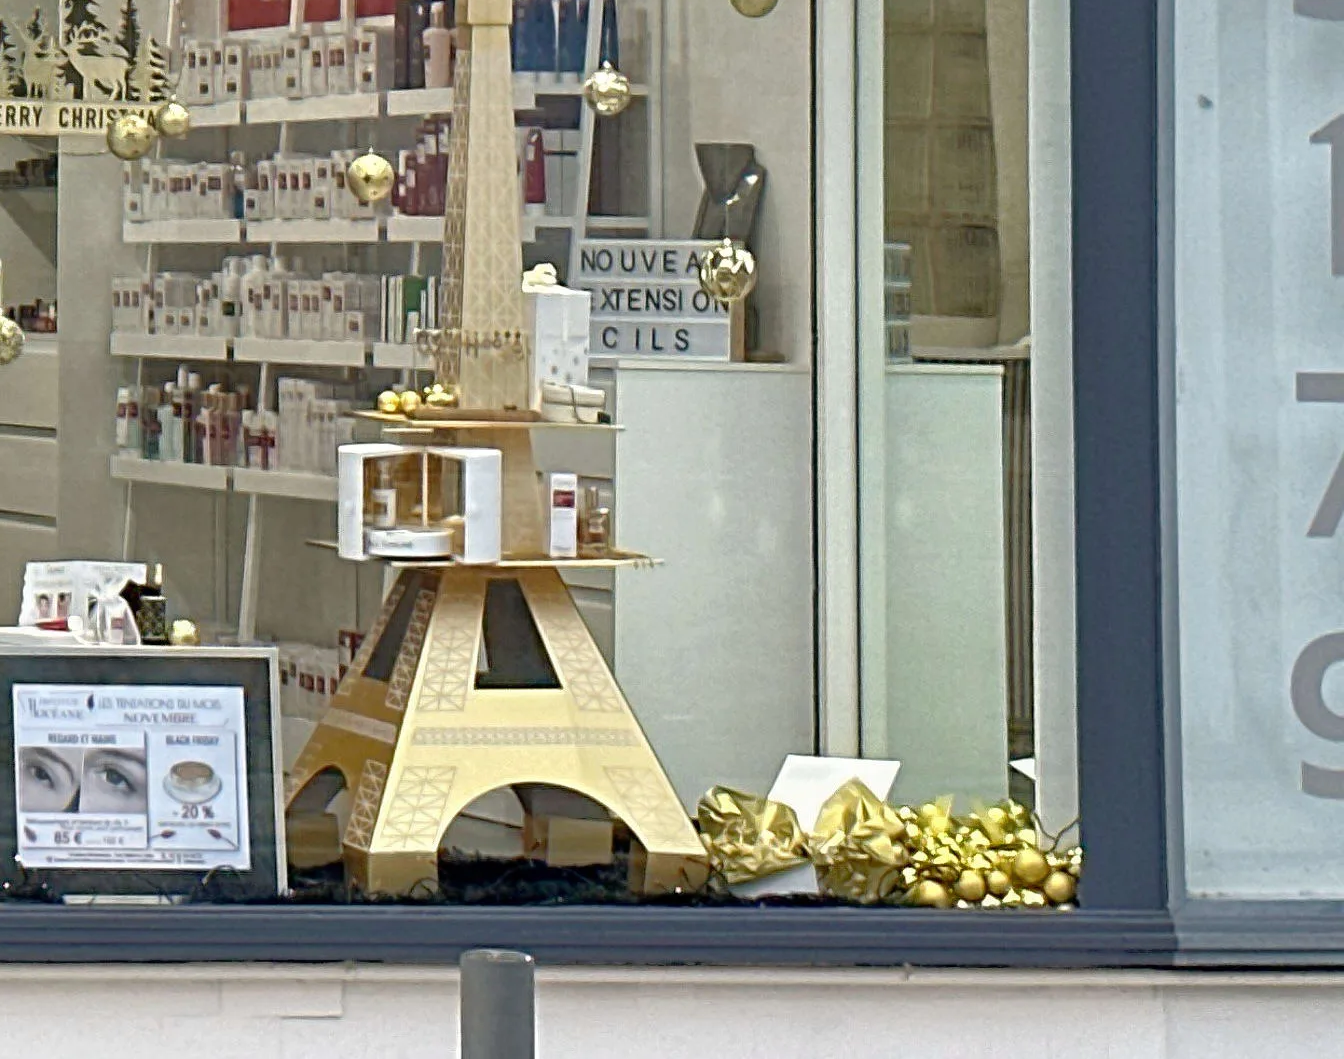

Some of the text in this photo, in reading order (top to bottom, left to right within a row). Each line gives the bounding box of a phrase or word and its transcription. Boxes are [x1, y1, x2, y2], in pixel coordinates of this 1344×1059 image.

[602, 326, 690, 352] CILS
[124, 712, 197, 724] NOVEMBRE
[181, 805, 200, 819] 20
